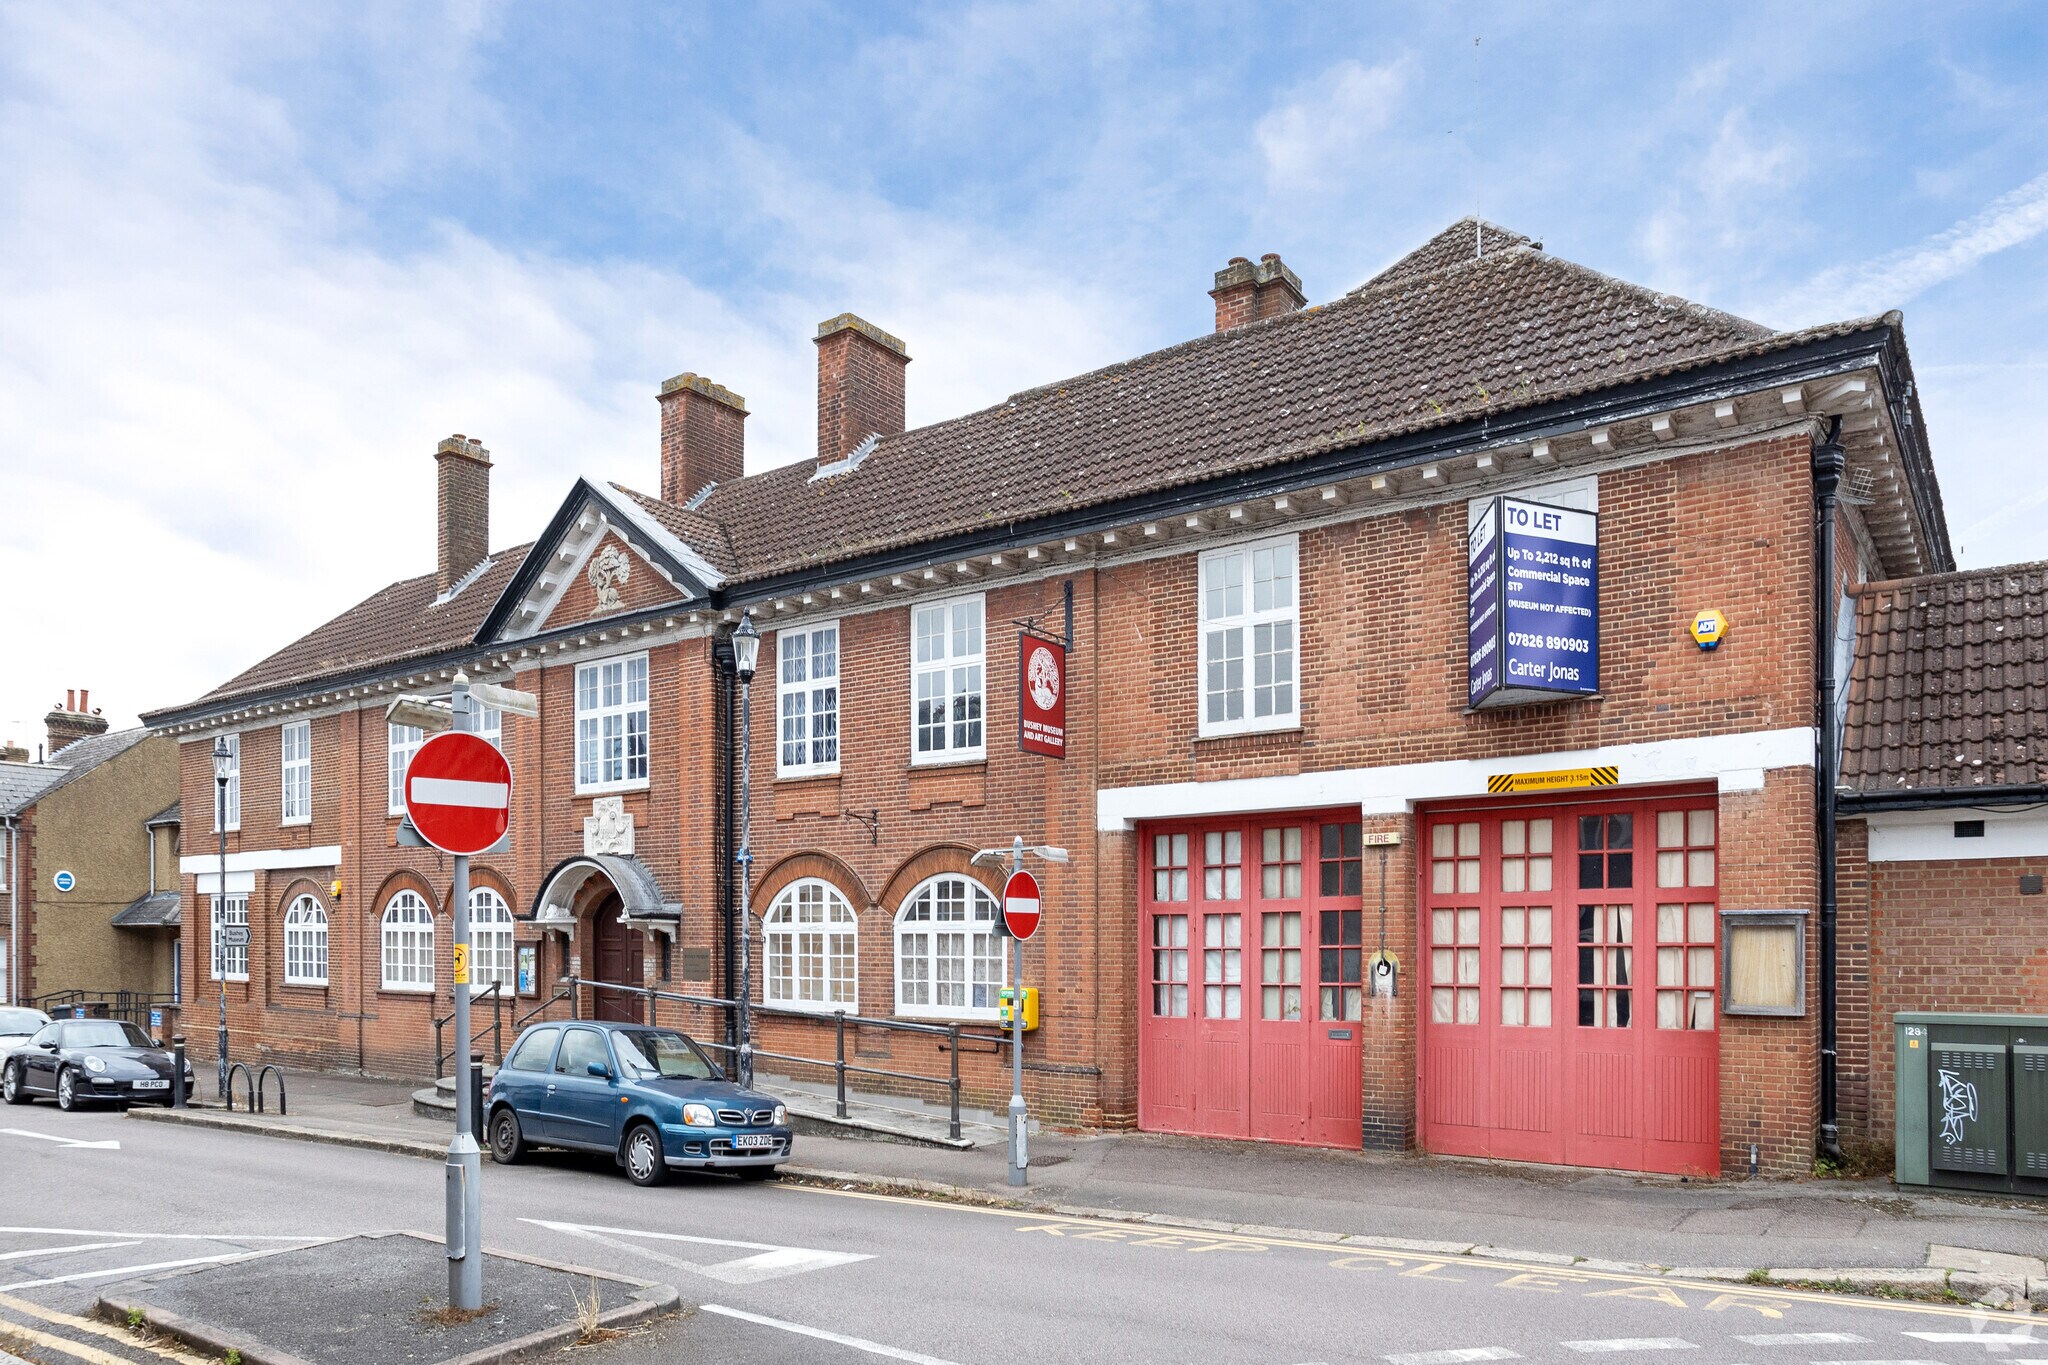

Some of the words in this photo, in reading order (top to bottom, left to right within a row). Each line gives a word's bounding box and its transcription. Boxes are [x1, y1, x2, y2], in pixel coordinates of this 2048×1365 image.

[1507, 506, 1529, 526] TO
[1534, 511, 1562, 531] LET
[1507, 546, 1520, 561] Up
[1521, 549, 1534, 561] To
[1535, 551, 1558, 565] 2,212
[1559, 556, 1570, 568] sq
[1571, 556, 1580, 568] ft
[1581, 558, 1591, 569] of
[1507, 565, 1561, 583] Commercial
[1562, 573, 1590, 586] Space
[1507, 581, 1523, 591] STP
[1508, 599, 1539, 611] (MUSEUM
[1539, 603, 1554, 612] NOT
[1555, 605, 1591, 617] AFFECTED)
[1698, 620, 1715, 633] ADT
[1508, 632, 1544, 648] 07826
[1546, 636, 1589, 653] 890903
[1508, 658, 1546, 678] Carter
[1547, 661, 1579, 682] Jonas
[1023, 730, 1034, 740] AND
[1043, 724, 1063, 736] MUSEUM
[1515, 777, 1545, 785] MAXIMUM
[1546, 774, 1568, 784] HEIGHT
[1368, 834, 1390, 844] FIRE
[737, 1134, 758, 1146] EK03
[1015, 1223, 1269, 1252] KEEP
[1327, 1256, 1793, 1320] CLEAR
